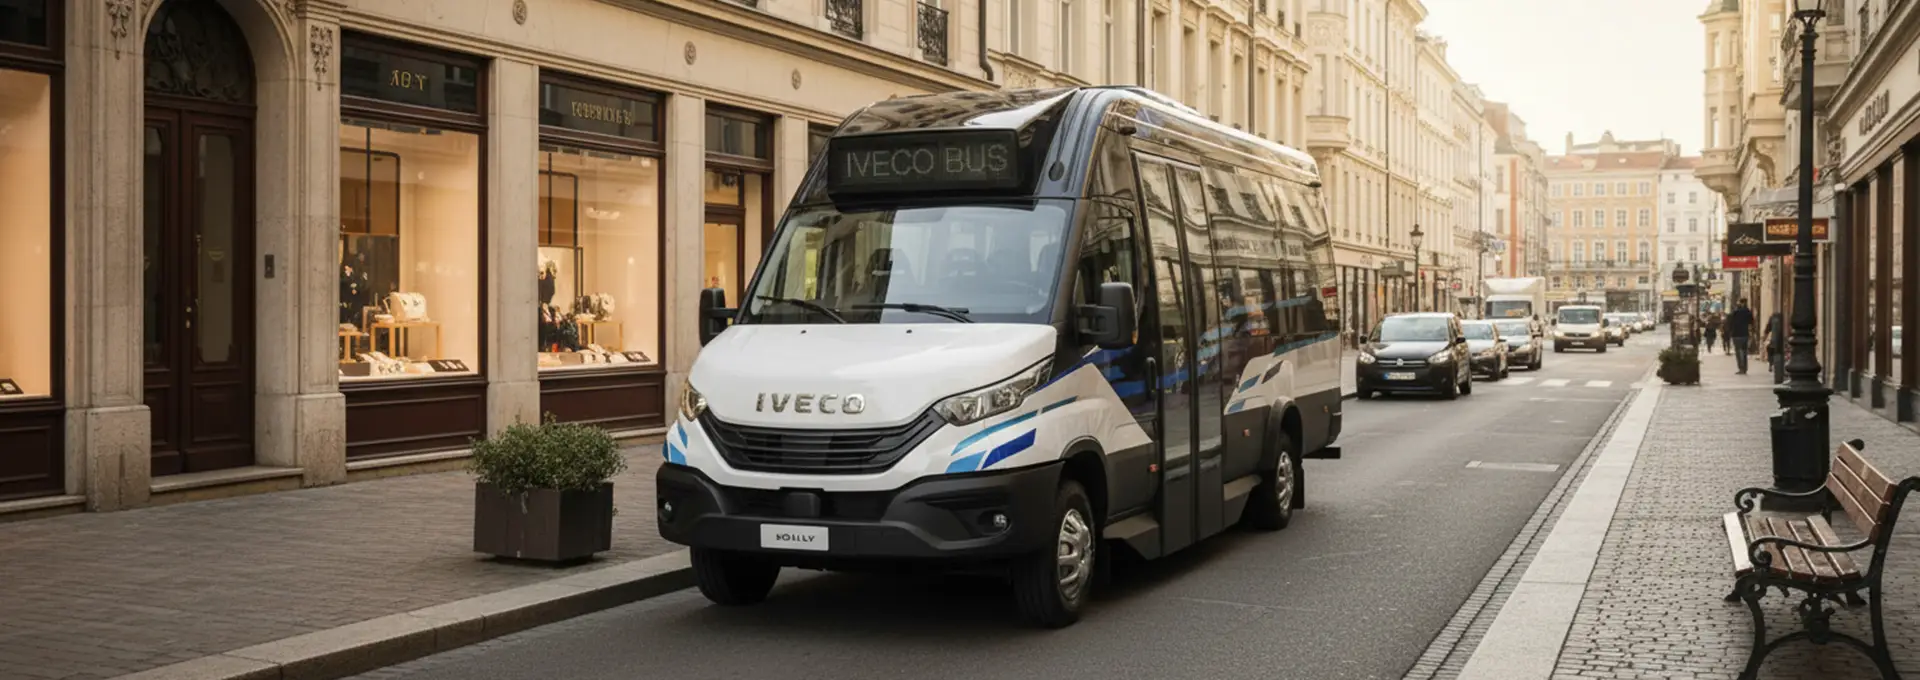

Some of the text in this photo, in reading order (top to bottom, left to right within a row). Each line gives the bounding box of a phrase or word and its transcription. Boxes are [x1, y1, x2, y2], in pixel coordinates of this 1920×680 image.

[847, 144, 1008, 177] IVECO BUS
[756, 392, 866, 414] IVECO
